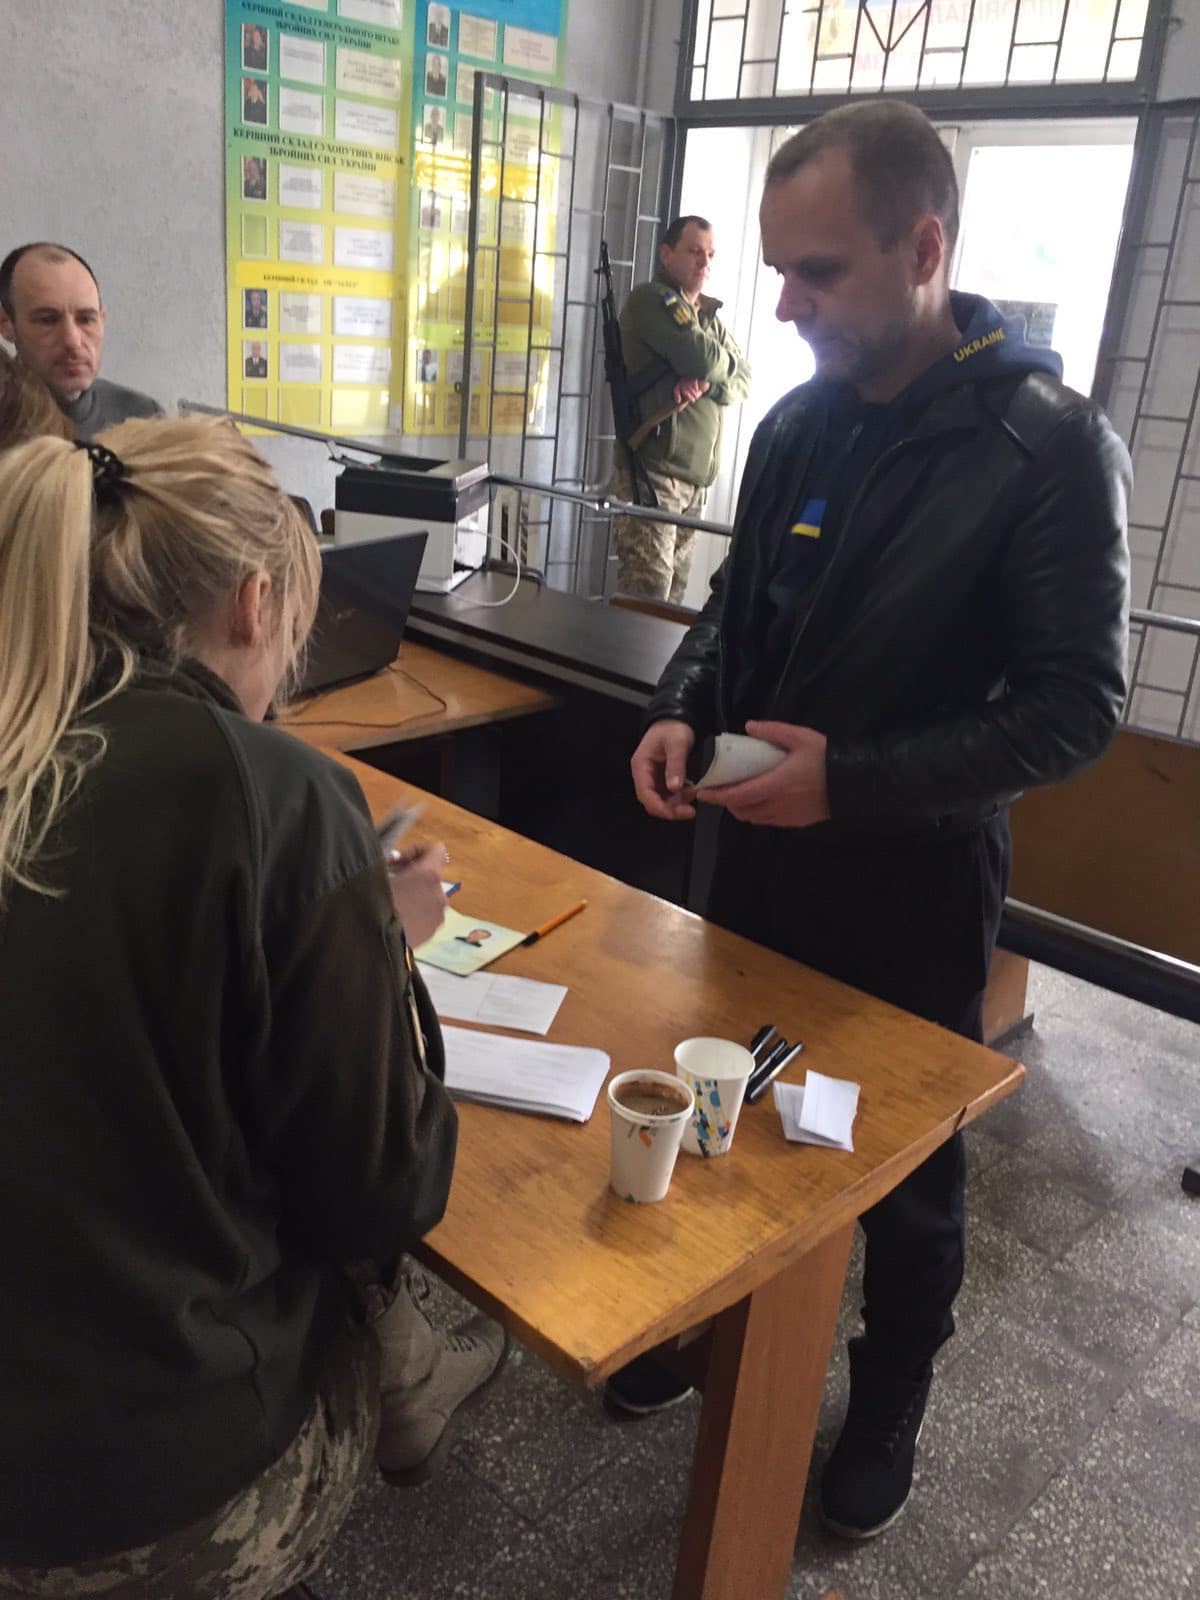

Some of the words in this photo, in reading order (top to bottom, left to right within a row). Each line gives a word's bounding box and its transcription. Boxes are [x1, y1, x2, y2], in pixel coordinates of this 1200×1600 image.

[233, 128, 280, 145] КЕРІВНИЙ
[282, 136, 312, 150] СКЛАД
[954, 328, 1005, 361] UKRAINE
